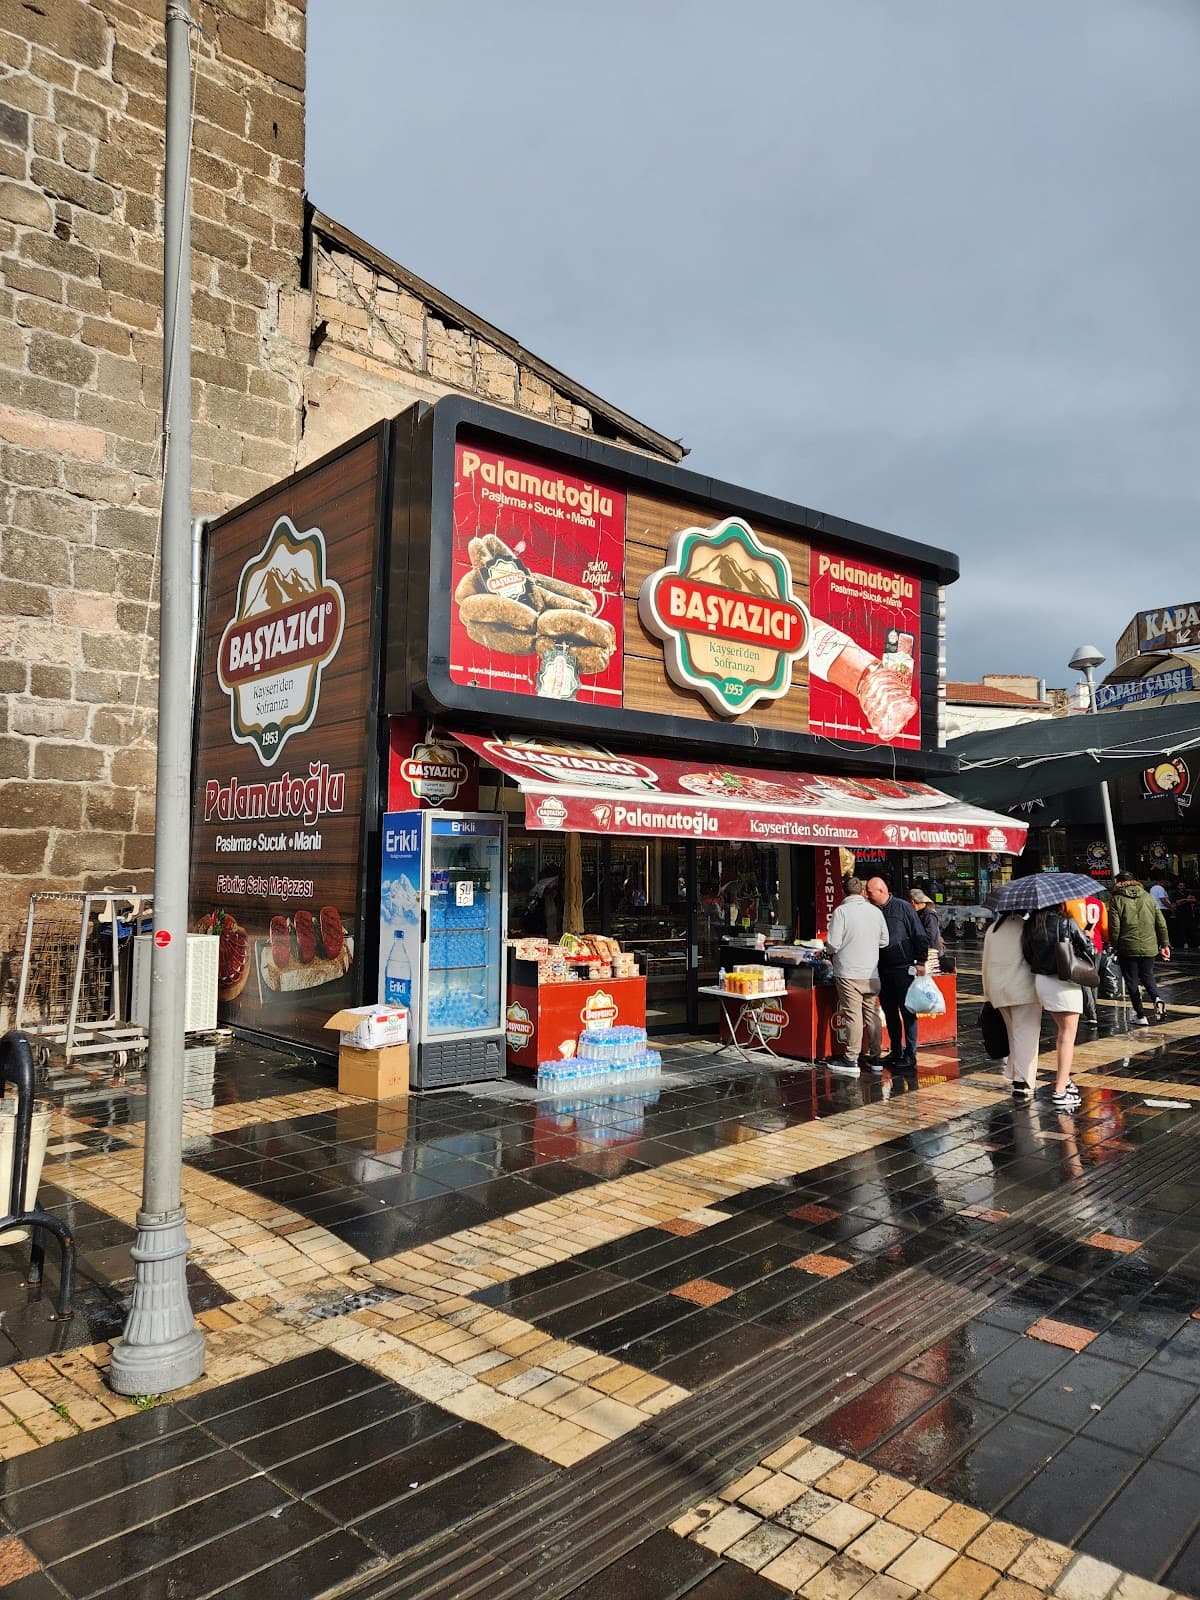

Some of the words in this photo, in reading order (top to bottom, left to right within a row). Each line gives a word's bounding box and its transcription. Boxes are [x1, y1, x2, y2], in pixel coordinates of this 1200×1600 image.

[462, 451, 613, 518] Palamutoğlu
[481, 487, 527, 509] Pastırma
[533, 501, 564, 519] Sucuk
[570, 511, 596, 529] Mantı
[582, 570, 611, 584] Doğal
[818, 554, 913, 599] Palamutoğlu
[862, 590, 883, 603] Sucuk
[670, 585, 791, 641] BAŞYAZICI
[229, 603, 326, 671] BAŞYAZICI
[709, 641, 760, 661] Kayseri'den
[714, 656, 755, 673] Sofranıza
[253, 678, 294, 700] Kayseri'den
[724, 683, 743, 696] 1953
[255, 698, 289, 716] Sofranıza
[262, 730, 279, 745] 1953
[408, 763, 460, 778] BAŞYAZICI
[503, 747, 634, 776] BAŞYAZICI
[205, 761, 345, 825] Palamutoğlu
[451, 821, 476, 832] Erikli
[614, 806, 718, 836] Palamutoğlu
[750, 819, 810, 836] Kayseri'den
[813, 824, 859, 839] Sofranıza
[258, 832, 286, 851] Sucuk
[386, 830, 419, 852] Erikli
[899, 825, 974, 846] Palamutoğlu
[824, 849, 835, 930] PALAMUTO
[1078, 903, 1099, 923] 10
[390, 980, 406, 993] Erikli
